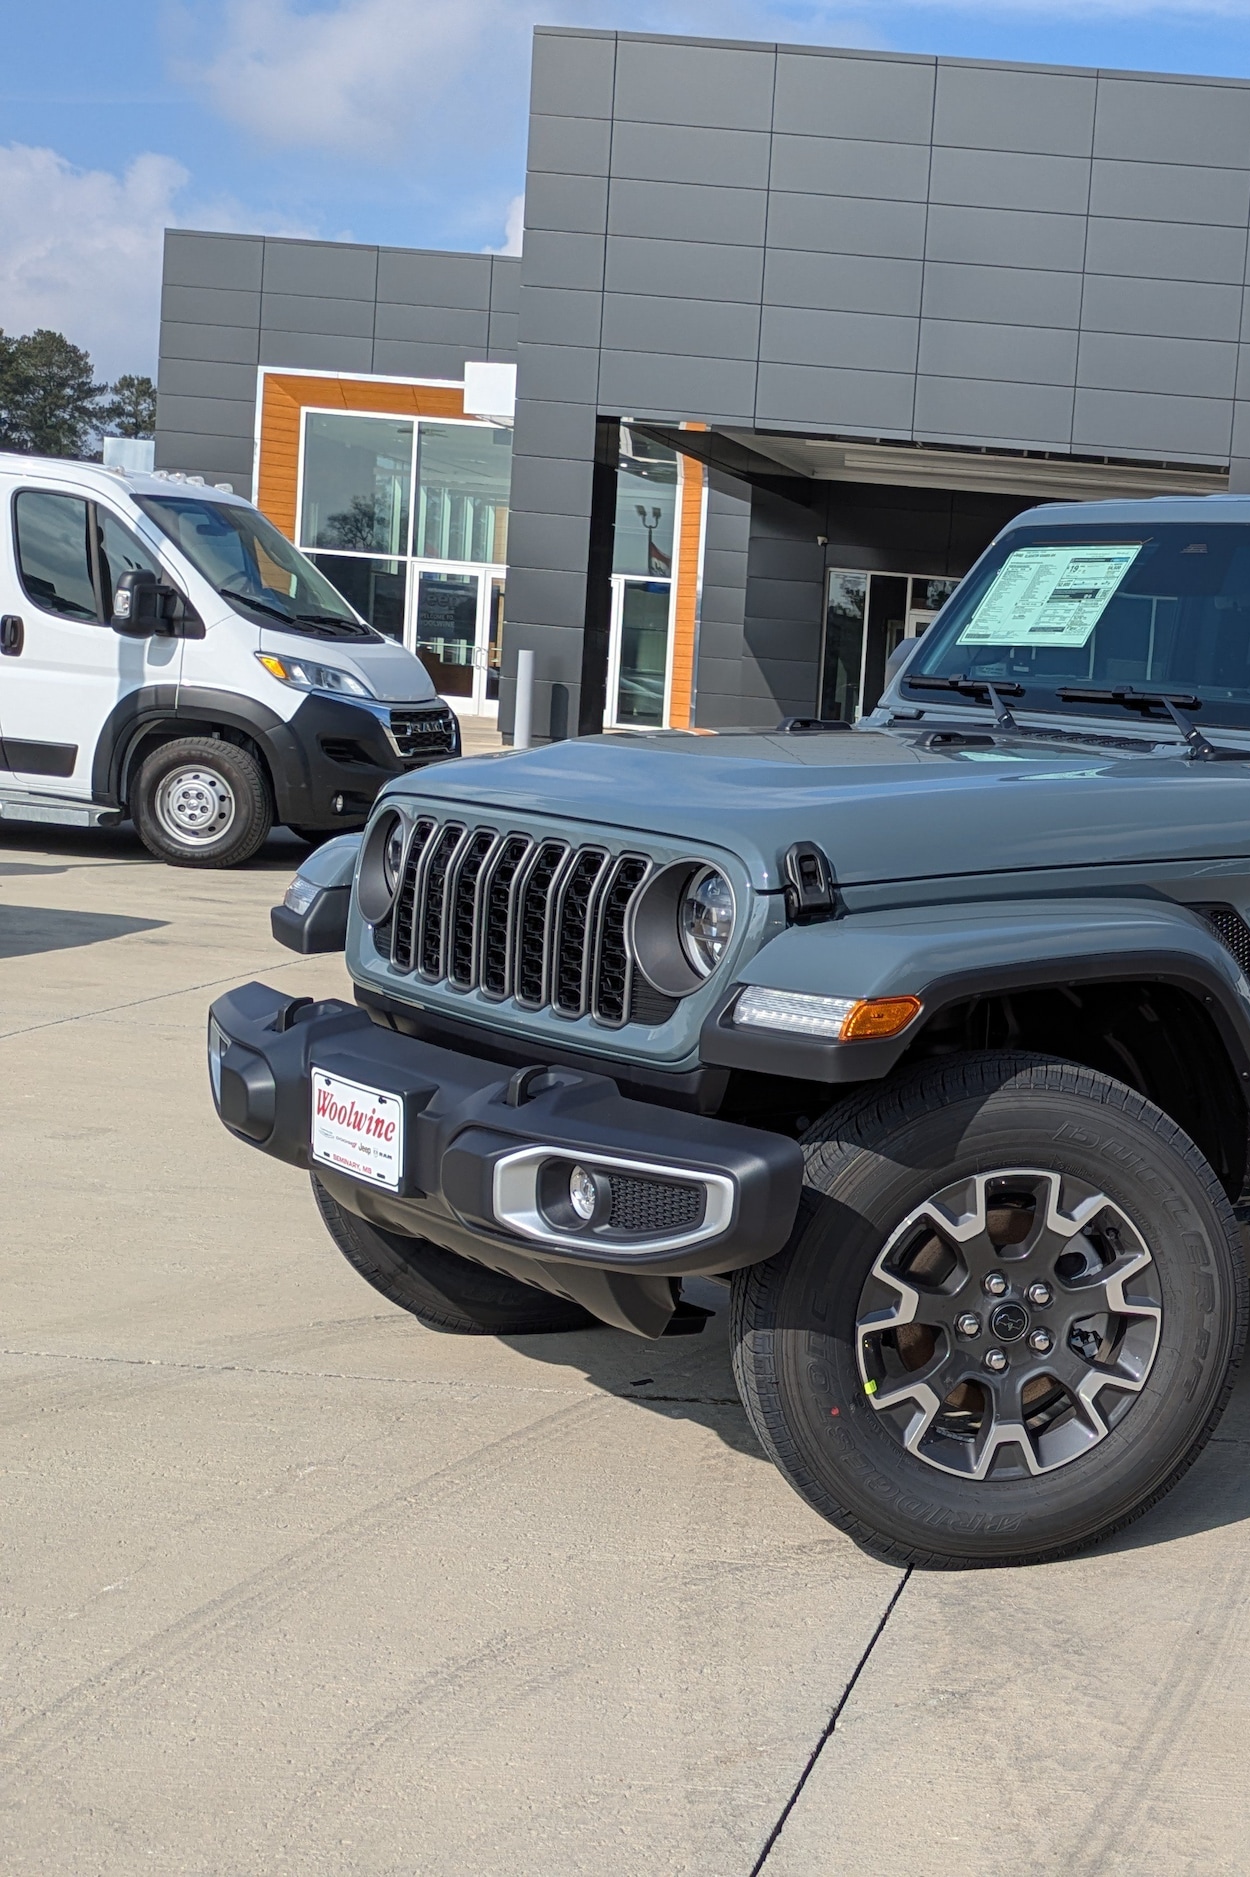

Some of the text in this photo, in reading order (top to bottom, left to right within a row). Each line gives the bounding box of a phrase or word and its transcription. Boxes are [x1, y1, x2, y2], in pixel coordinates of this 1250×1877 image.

[412, 721, 441, 733] RAM
[317, 1088, 396, 1142] Woolwine
[358, 1143, 371, 1155] Jeep
[379, 1152, 392, 1160] RAM
[1052, 1120, 1216, 1315] DUELER
[806, 1292, 1028, 1534] BRIDGESTONE
